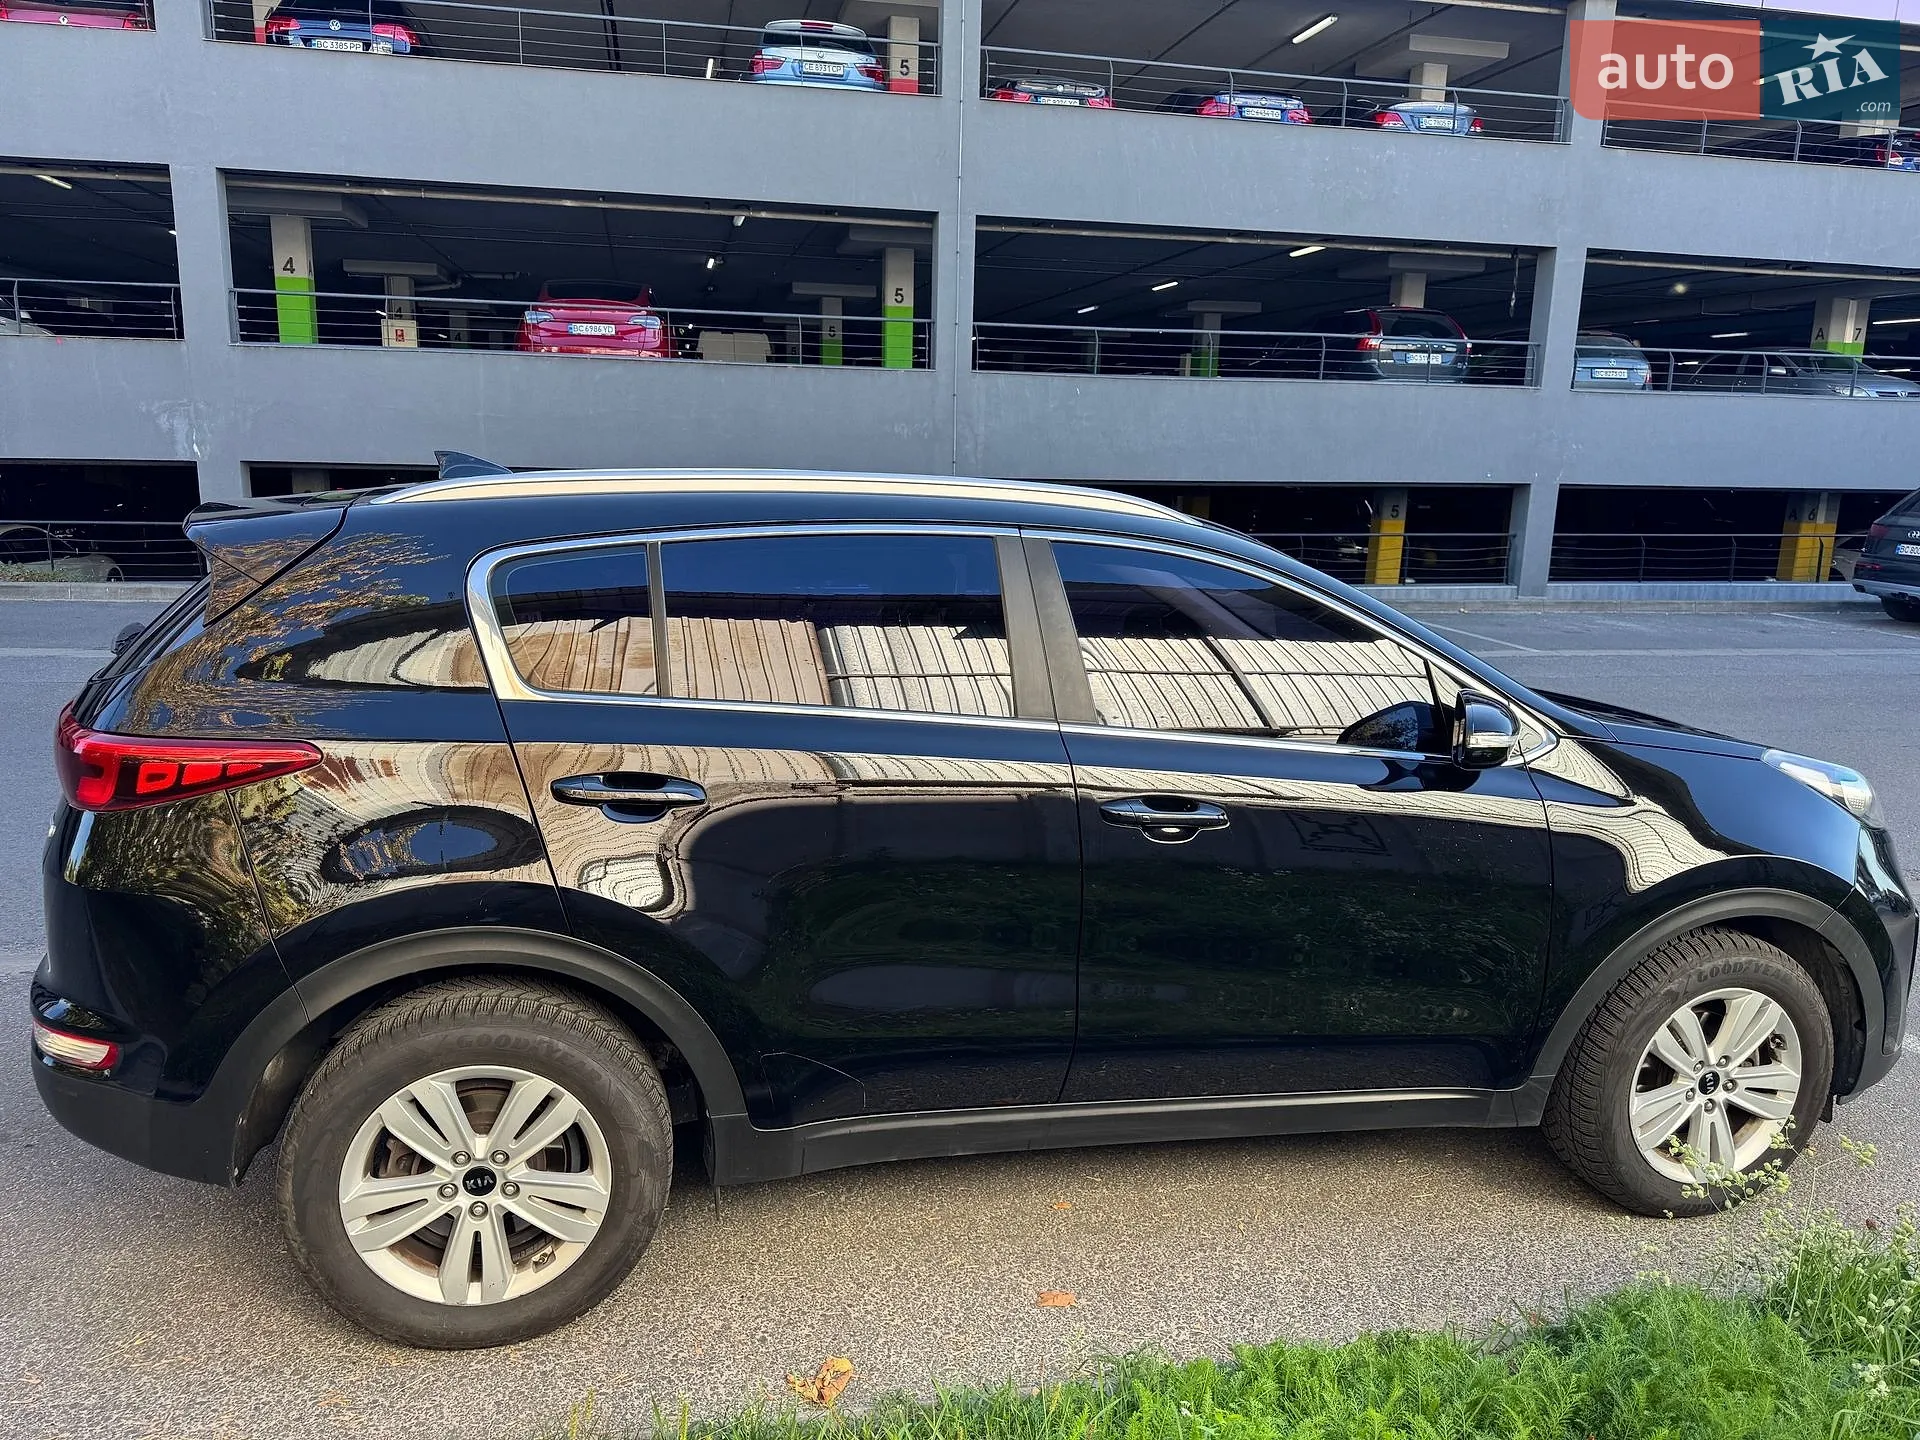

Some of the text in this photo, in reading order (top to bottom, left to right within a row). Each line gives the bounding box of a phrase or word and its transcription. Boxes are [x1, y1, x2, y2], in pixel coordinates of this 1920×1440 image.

[900, 59, 910, 76] 5
[282, 256, 295, 274] 4
[894, 287, 904, 303] 5
[828, 325, 836, 338] 5
[1815, 328, 1862, 341] A 7
[1390, 504, 1400, 518] 5
[1807, 508, 1816, 521] 6
[1697, 961, 1793, 982] GOODYEA
[465, 1175, 494, 1190] KIA
